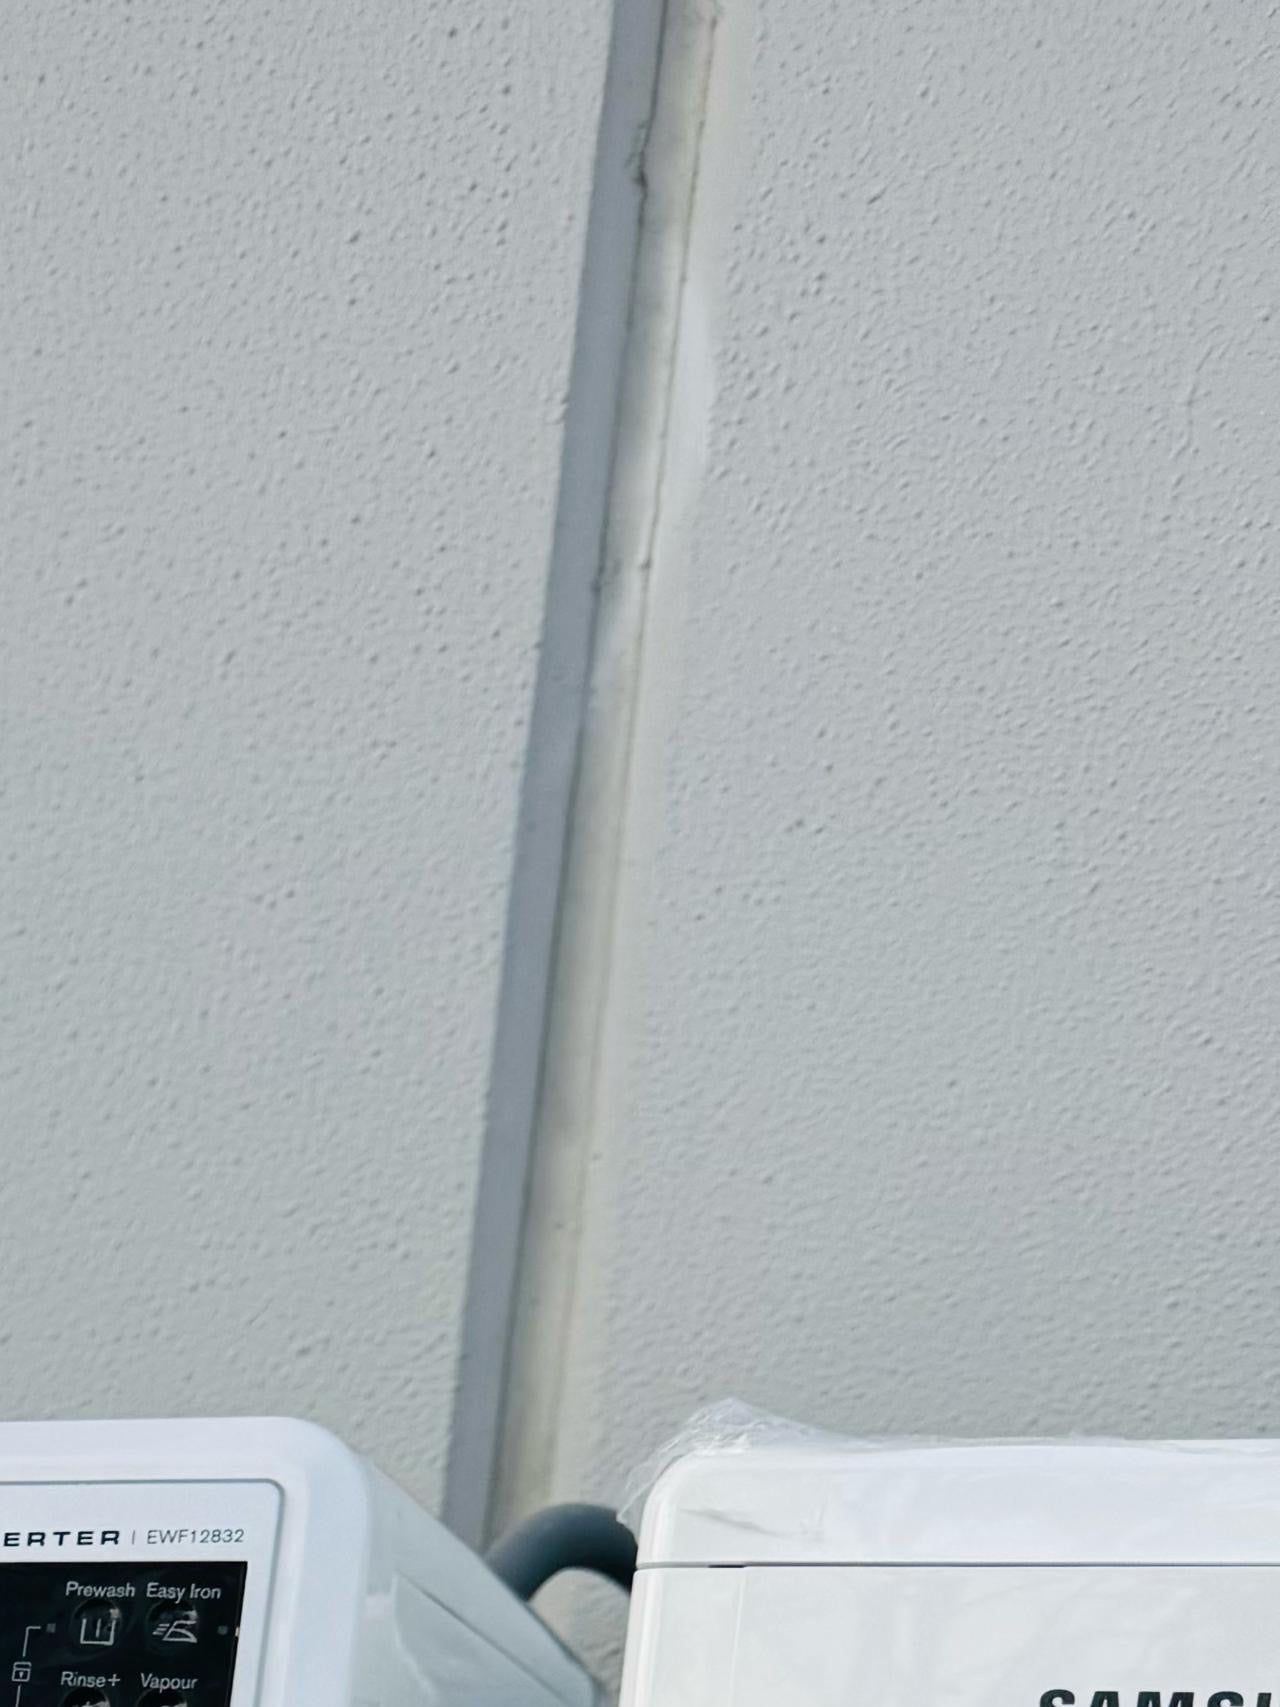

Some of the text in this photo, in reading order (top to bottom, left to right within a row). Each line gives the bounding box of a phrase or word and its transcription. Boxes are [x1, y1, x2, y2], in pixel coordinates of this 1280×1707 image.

[147, 1529, 245, 1545] EWF12832
[65, 1581, 135, 1598] Prewash
[146, 1583, 221, 1602] Easy Iron
[61, 1673, 120, 1687] Rinse+
[141, 1674, 197, 1691] Vapour
